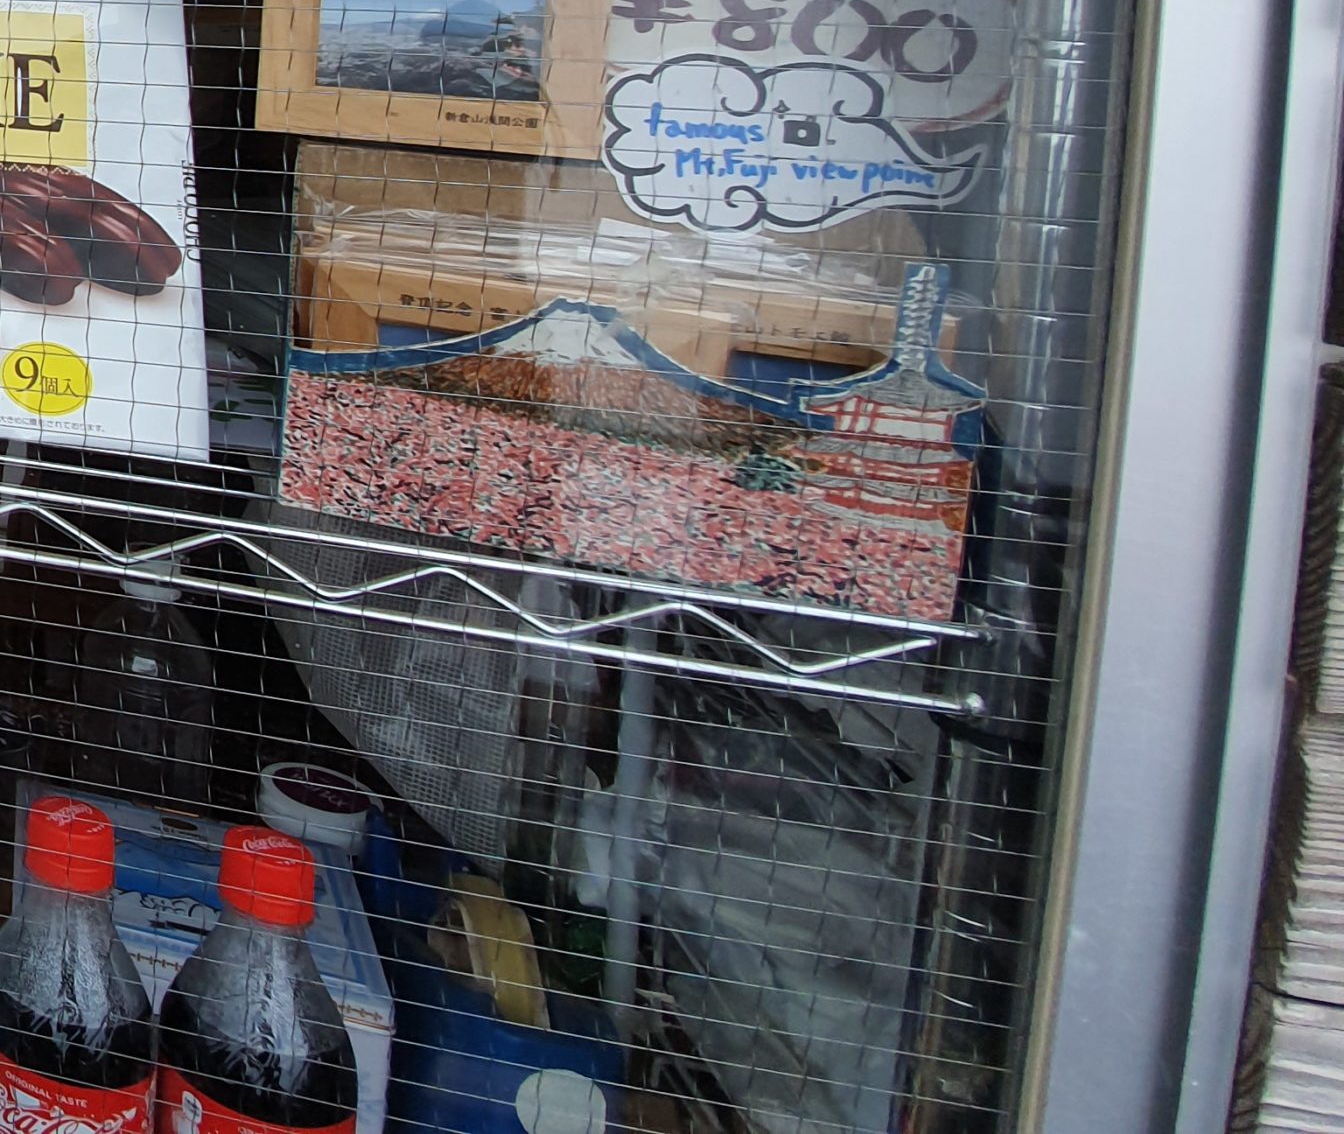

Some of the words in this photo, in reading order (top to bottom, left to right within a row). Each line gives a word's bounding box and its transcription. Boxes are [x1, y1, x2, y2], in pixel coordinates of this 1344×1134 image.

[644, 101, 766, 144] famous
[396, 291, 473, 320] 登頂記念
[13, 355, 80, 399] 9個入
[54, 1092, 89, 1108] TASTE
